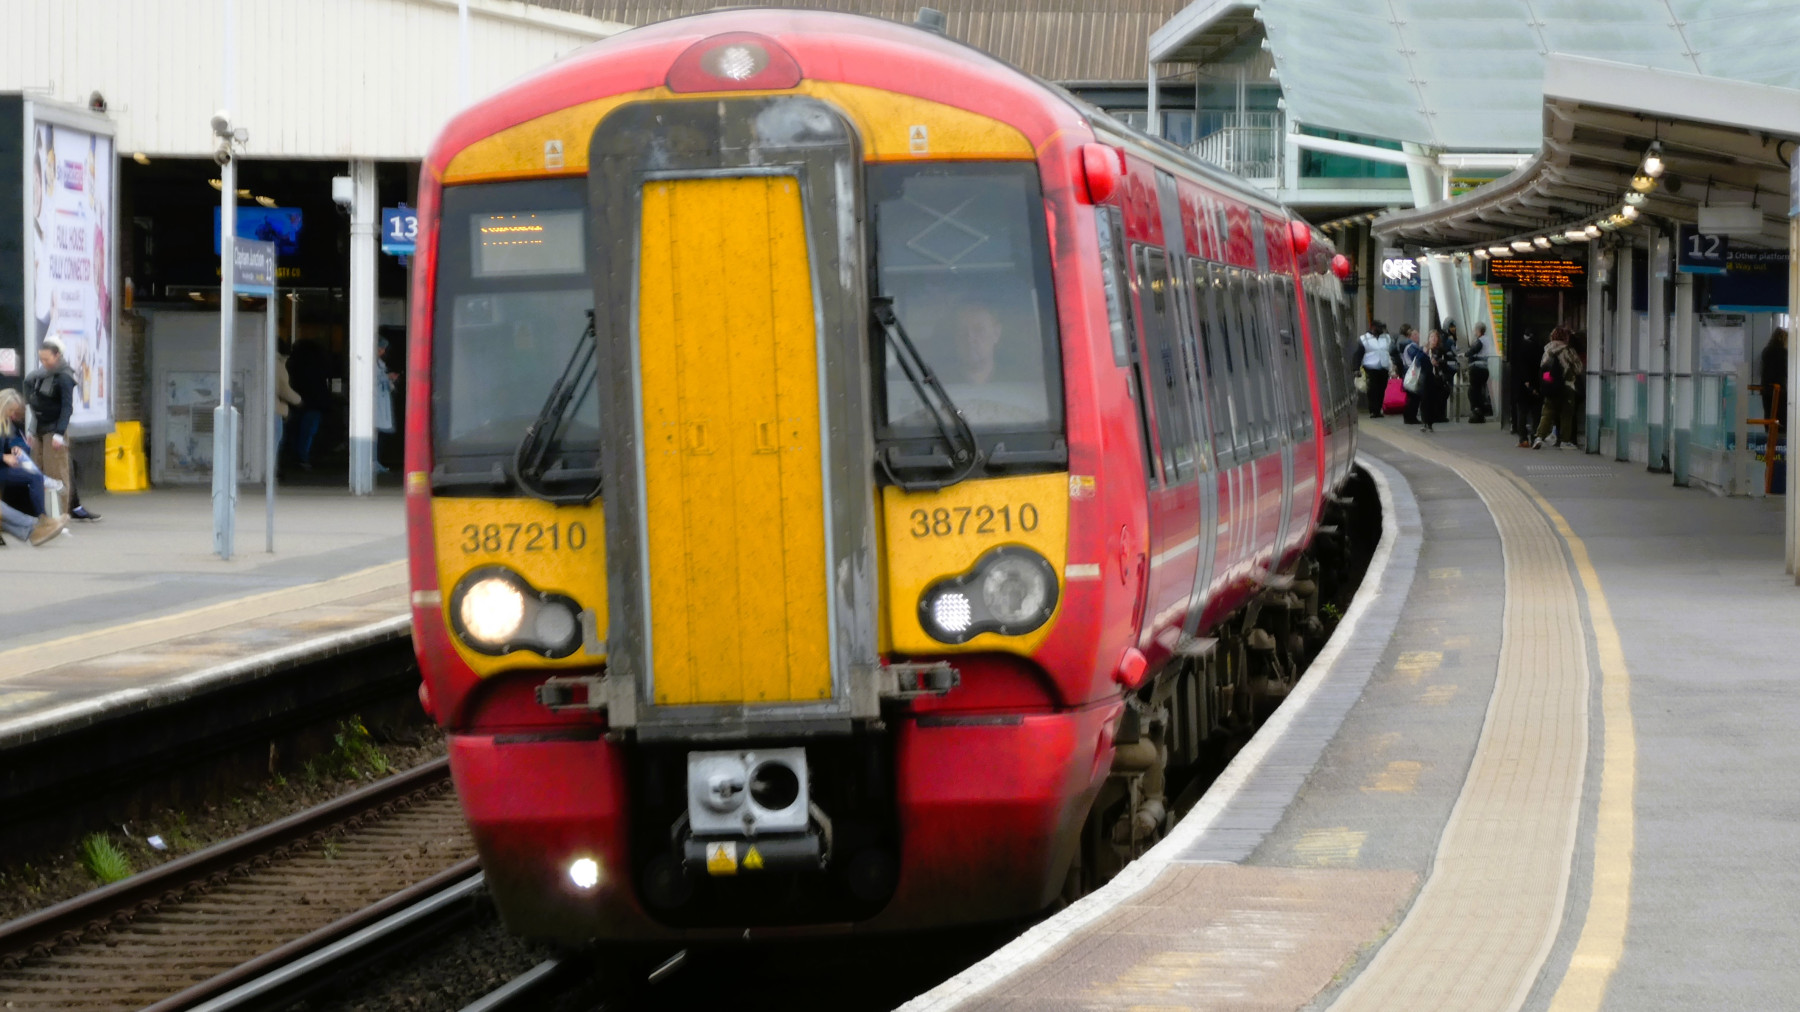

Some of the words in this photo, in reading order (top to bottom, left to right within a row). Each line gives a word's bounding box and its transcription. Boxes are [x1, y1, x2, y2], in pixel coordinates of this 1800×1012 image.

[390, 216, 418, 238] 13
[1688, 234, 1720, 257] 12
[1735, 252, 1757, 260] Other
[1760, 252, 1790, 261] platform
[910, 503, 1038, 538] 387210
[461, 522, 587, 554] 387210
